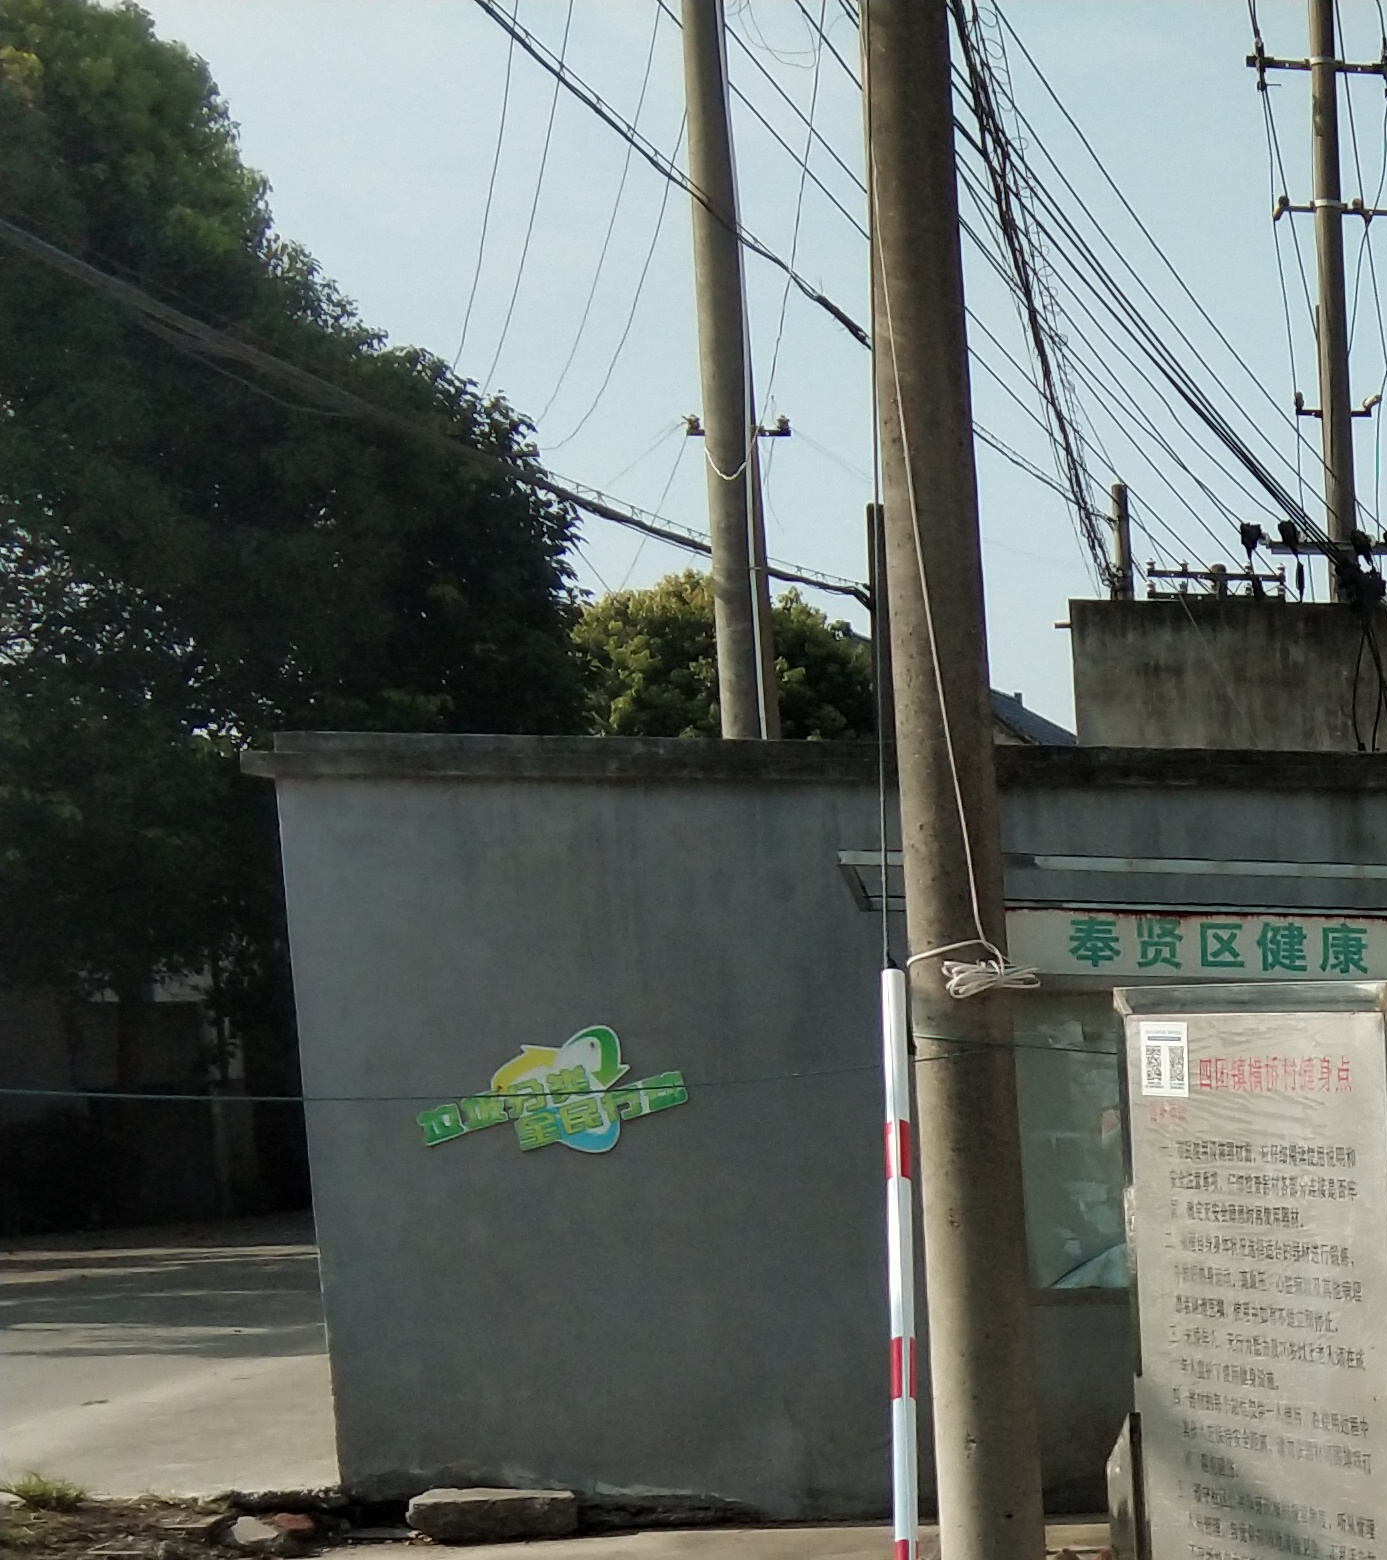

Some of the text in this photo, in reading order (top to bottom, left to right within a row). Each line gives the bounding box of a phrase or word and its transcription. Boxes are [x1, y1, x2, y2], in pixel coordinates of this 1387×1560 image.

[1069, 916, 1369, 974] 奉贤区健康
[416, 1064, 592, 1146] 垃圾分类
